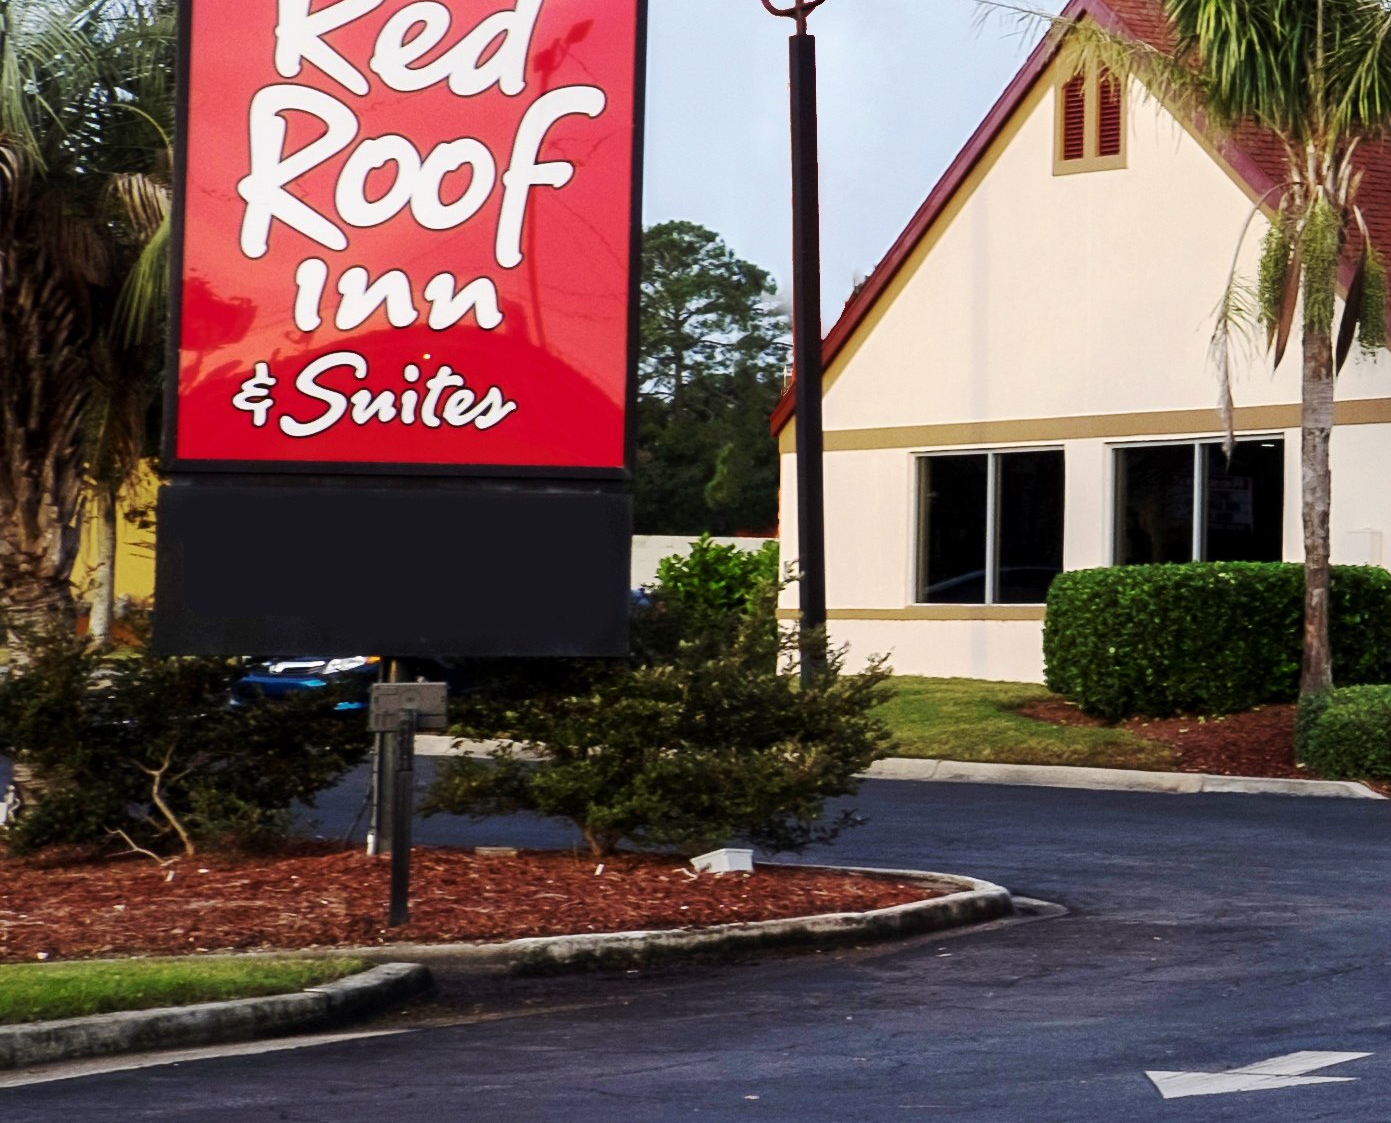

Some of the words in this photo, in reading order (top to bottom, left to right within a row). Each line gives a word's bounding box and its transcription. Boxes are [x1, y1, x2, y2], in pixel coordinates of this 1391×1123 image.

[237, 84, 606, 268] Roof
[232, 361, 277, 427] &
[279, 351, 518, 438] Suites
